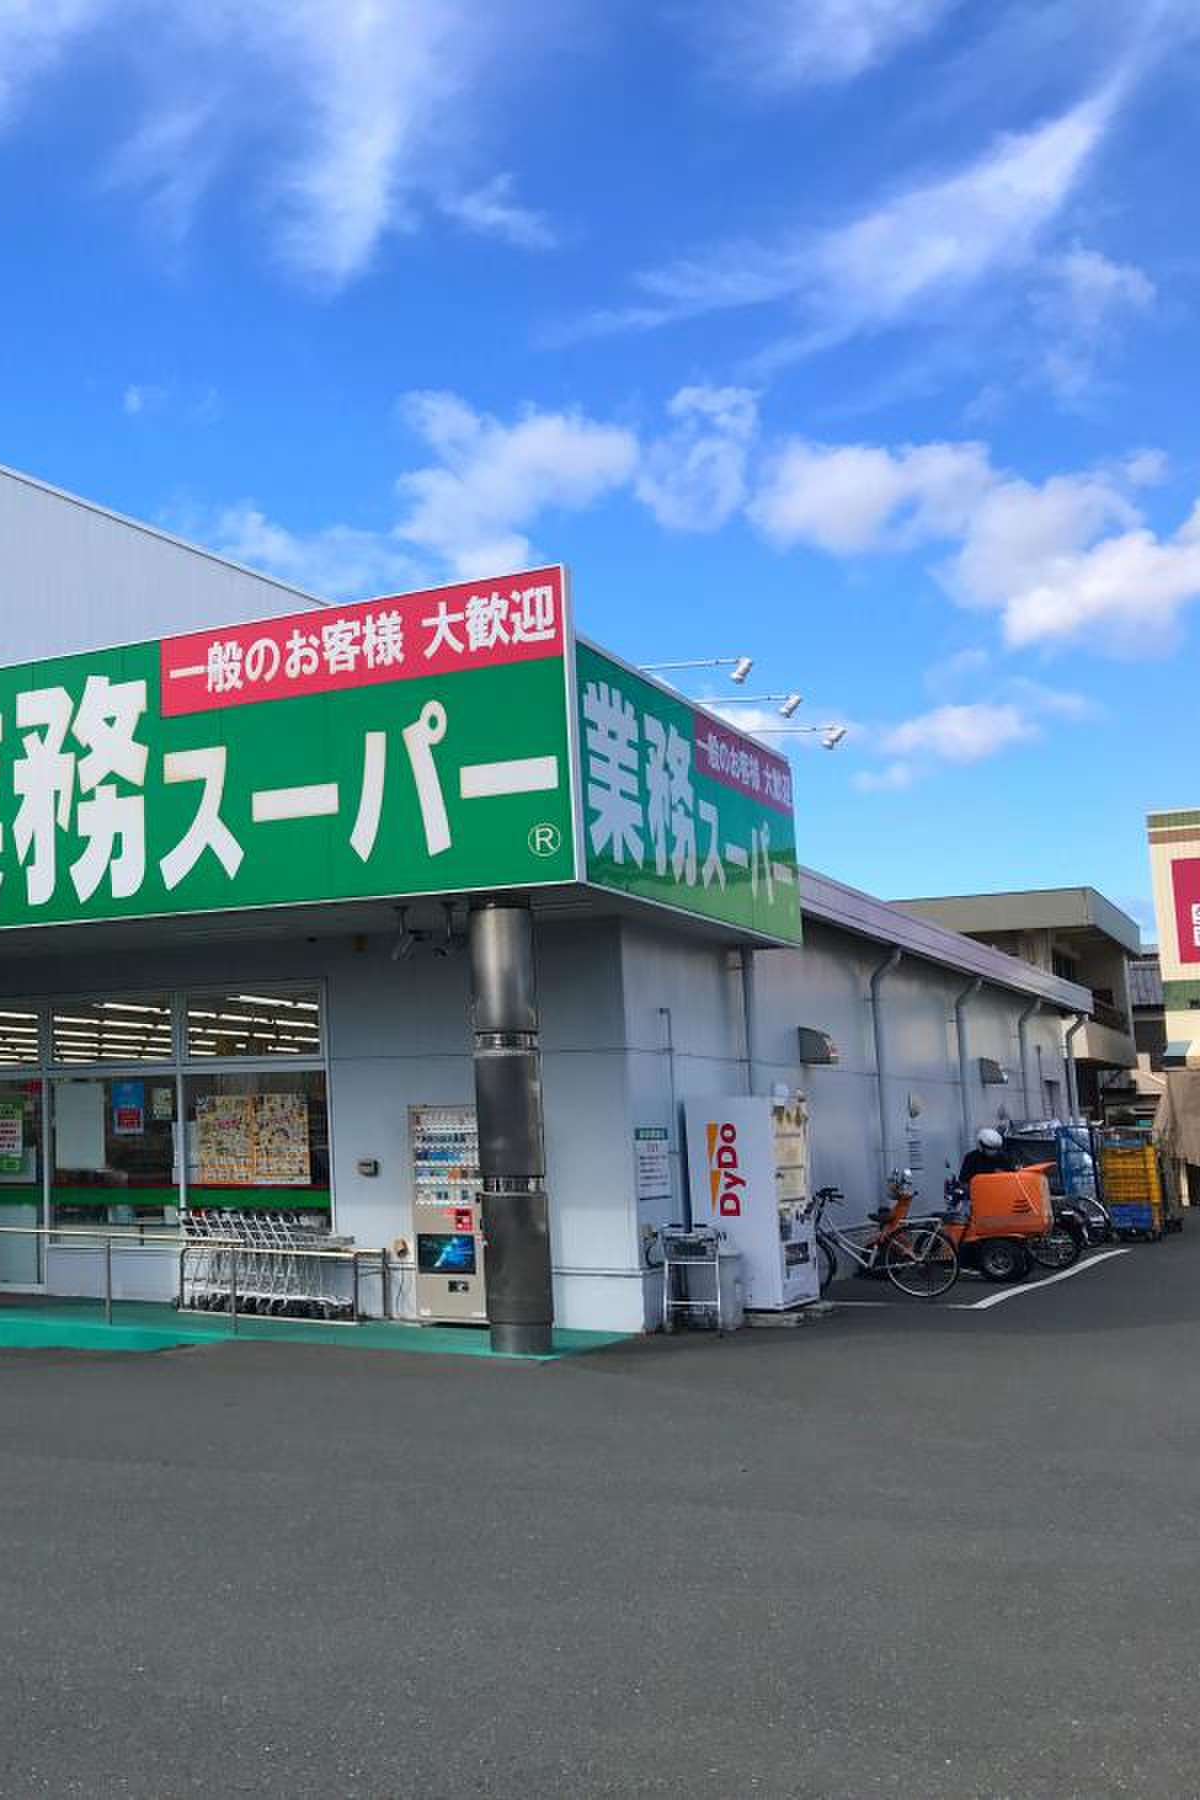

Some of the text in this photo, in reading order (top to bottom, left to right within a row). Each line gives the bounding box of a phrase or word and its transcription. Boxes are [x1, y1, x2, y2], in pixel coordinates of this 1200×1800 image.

[169, 585, 556, 693] 一般のお客様 大歓迎
[583, 681, 793, 904] 業務スーパー
